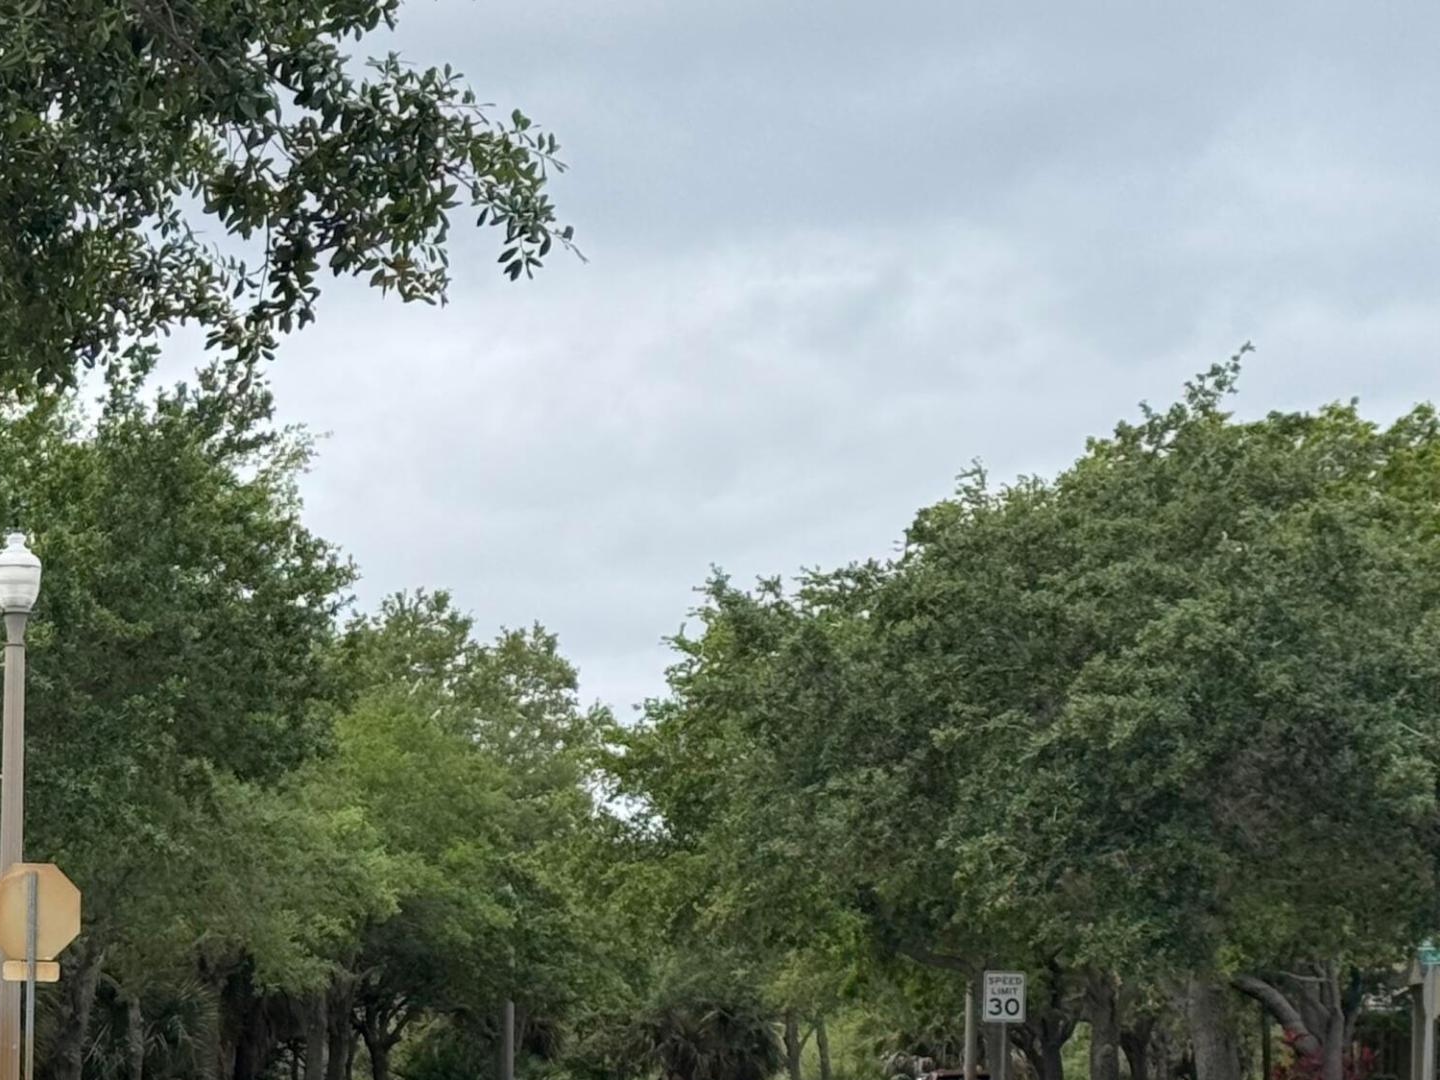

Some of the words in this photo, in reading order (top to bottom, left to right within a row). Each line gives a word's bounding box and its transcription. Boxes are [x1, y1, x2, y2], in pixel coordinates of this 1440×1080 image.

[988, 976, 1022, 985] SPEED
[991, 987, 1017, 995] LIMIT
[988, 998, 1020, 1016] 30
